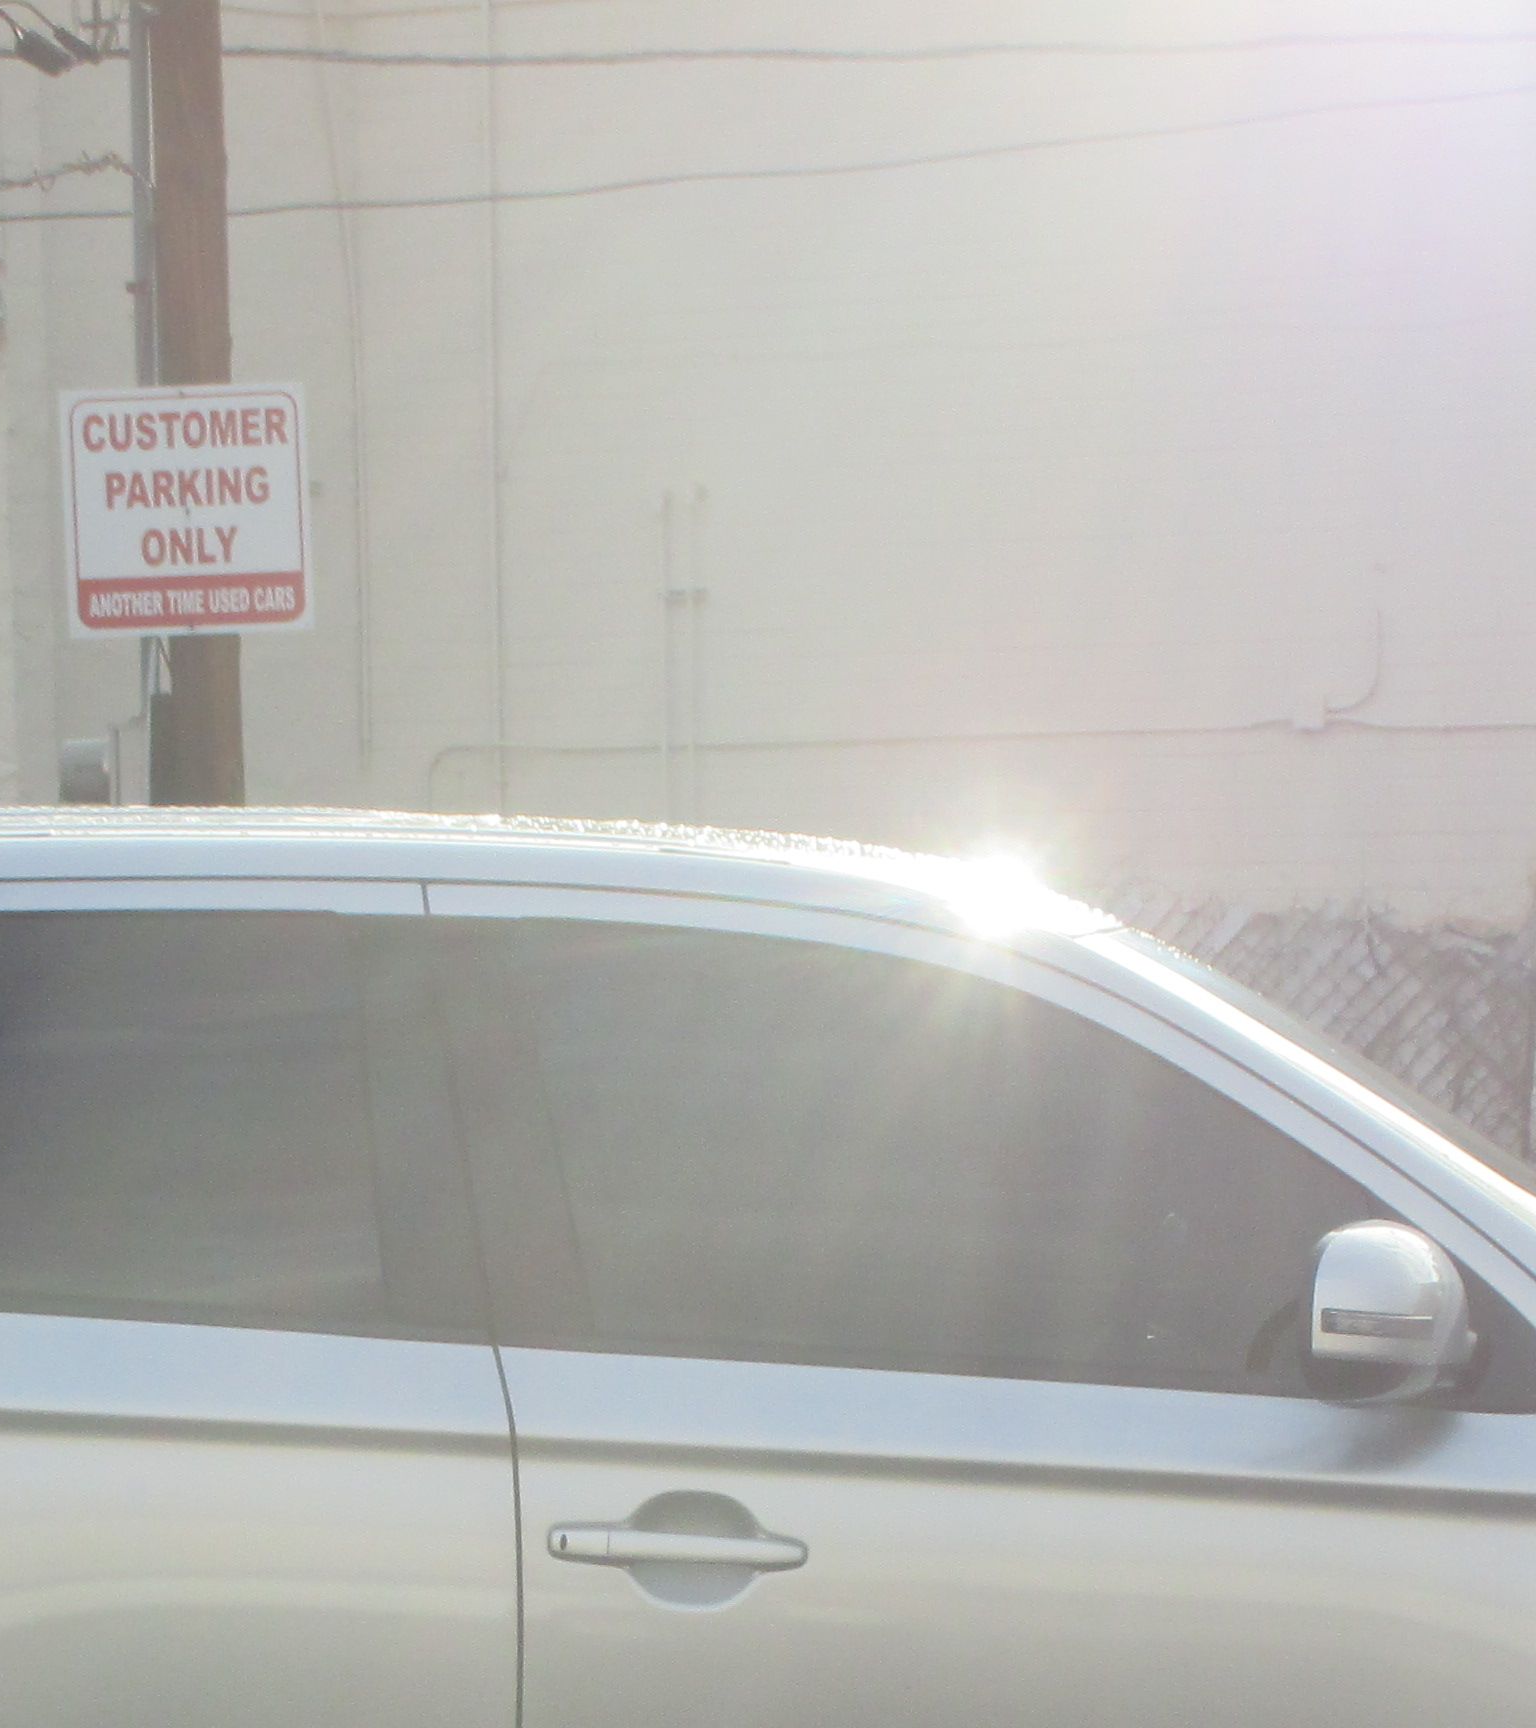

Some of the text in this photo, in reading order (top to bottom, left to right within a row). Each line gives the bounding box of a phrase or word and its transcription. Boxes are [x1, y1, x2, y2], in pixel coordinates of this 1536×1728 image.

[82, 407, 288, 452] CUSTOMER
[105, 466, 271, 510] PARKING
[141, 525, 238, 566] ONLY
[89, 585, 295, 617] ANOTHER TIME USED CARS
